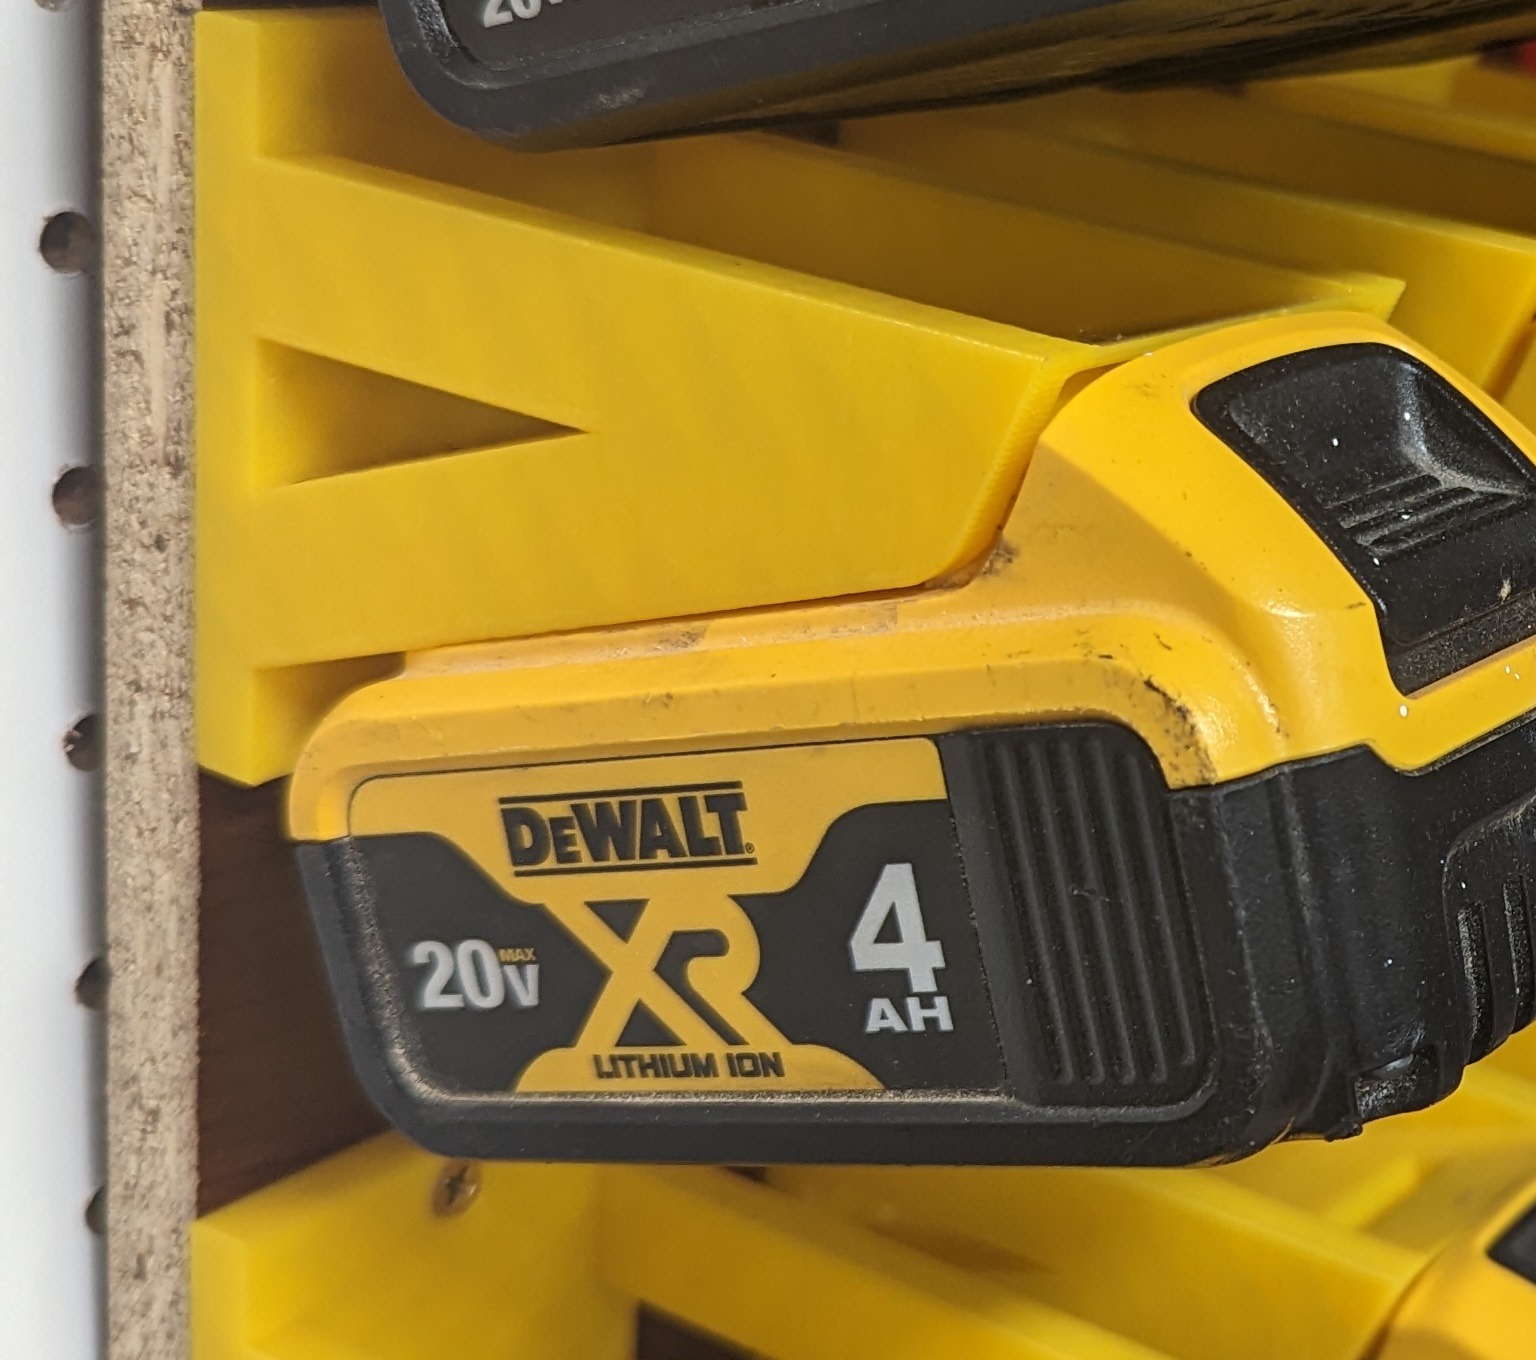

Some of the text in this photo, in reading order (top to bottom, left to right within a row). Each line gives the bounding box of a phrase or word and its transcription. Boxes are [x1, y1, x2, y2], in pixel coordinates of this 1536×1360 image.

[849, 863, 946, 993] 4
[497, 947, 537, 962] MAX
[545, 895, 793, 1047] XR
[865, 995, 954, 1034] AH
[592, 1051, 786, 1079] LITHIUM ION
